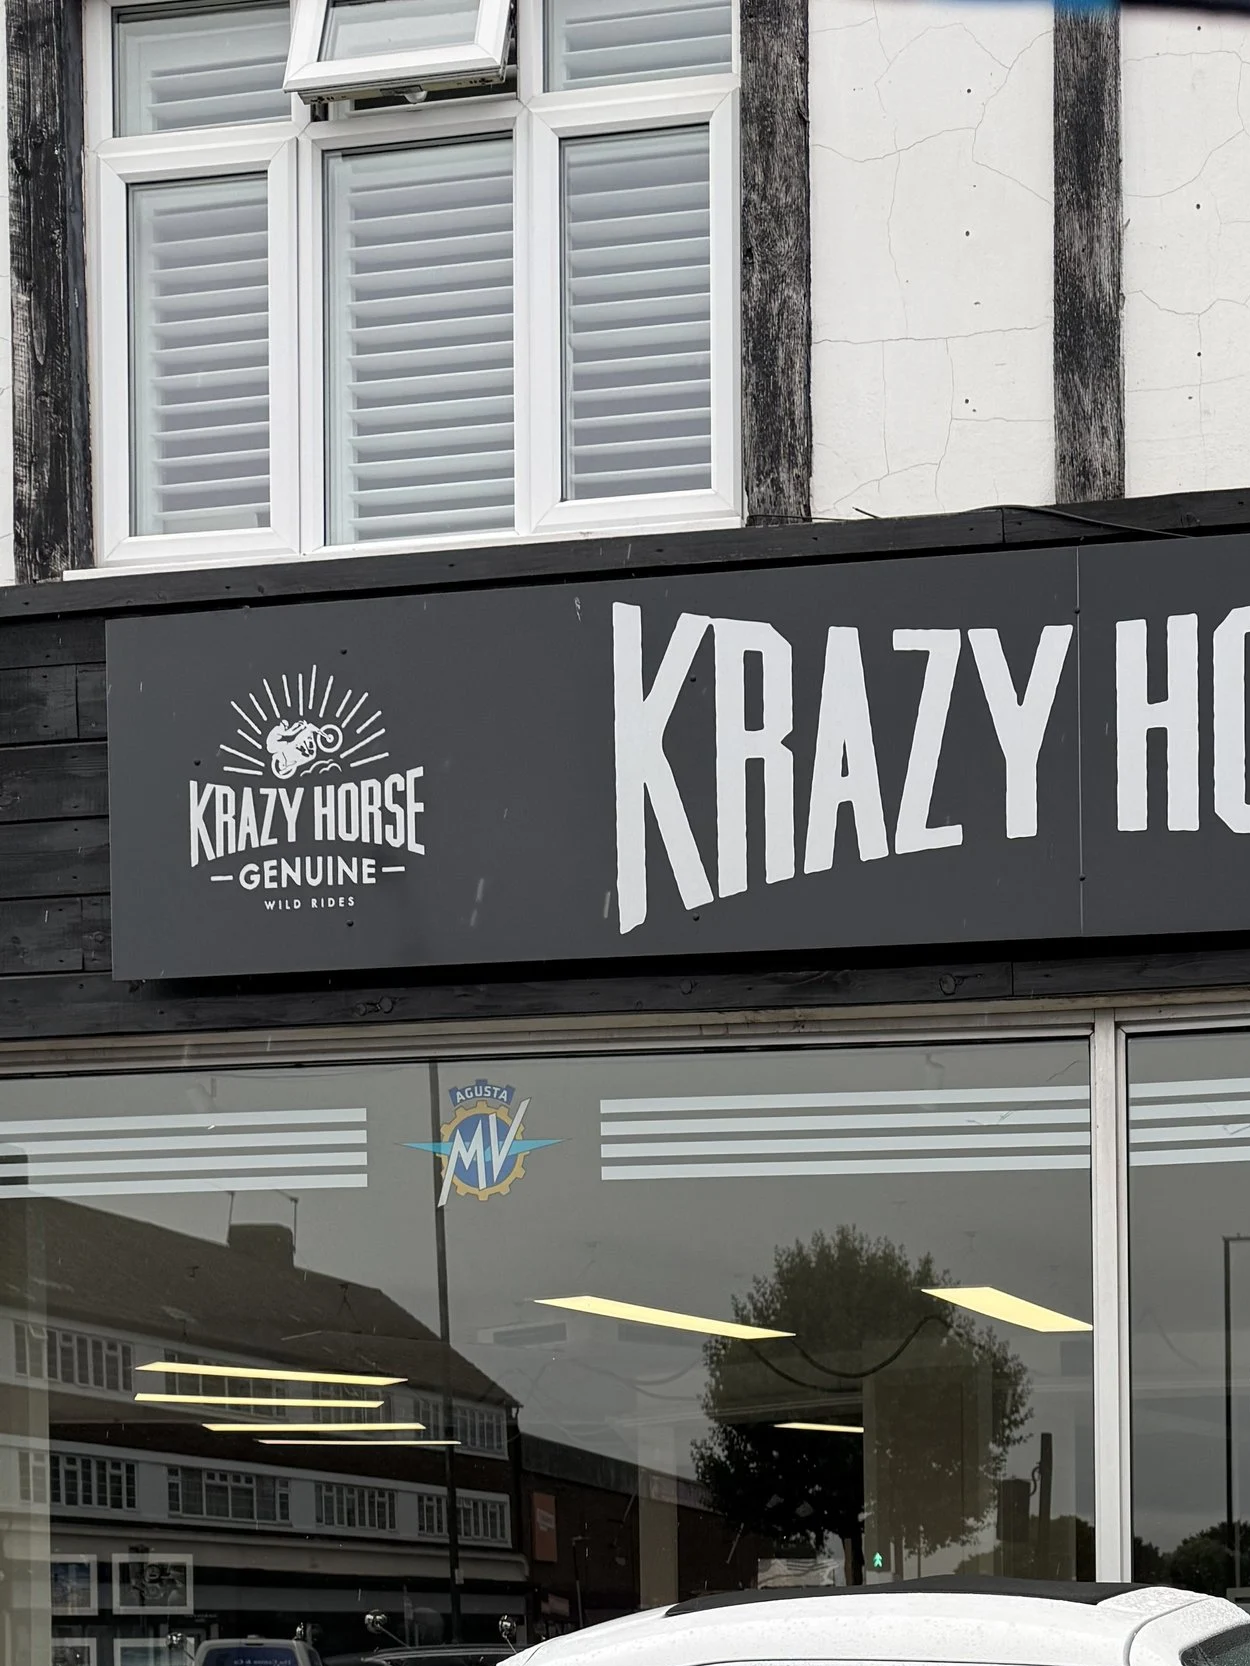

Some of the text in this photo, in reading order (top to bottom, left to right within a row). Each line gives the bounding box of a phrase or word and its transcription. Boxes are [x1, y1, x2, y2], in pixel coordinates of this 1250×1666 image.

[612, 601, 1074, 935] KRAZY
[189, 766, 425, 867] KRAZY HORSE
[239, 855, 376, 890] GENUINE
[264, 896, 355, 911] WILD RIDES
[455, 1085, 509, 1104] AGUSTA
[437, 1097, 532, 1208] MV
